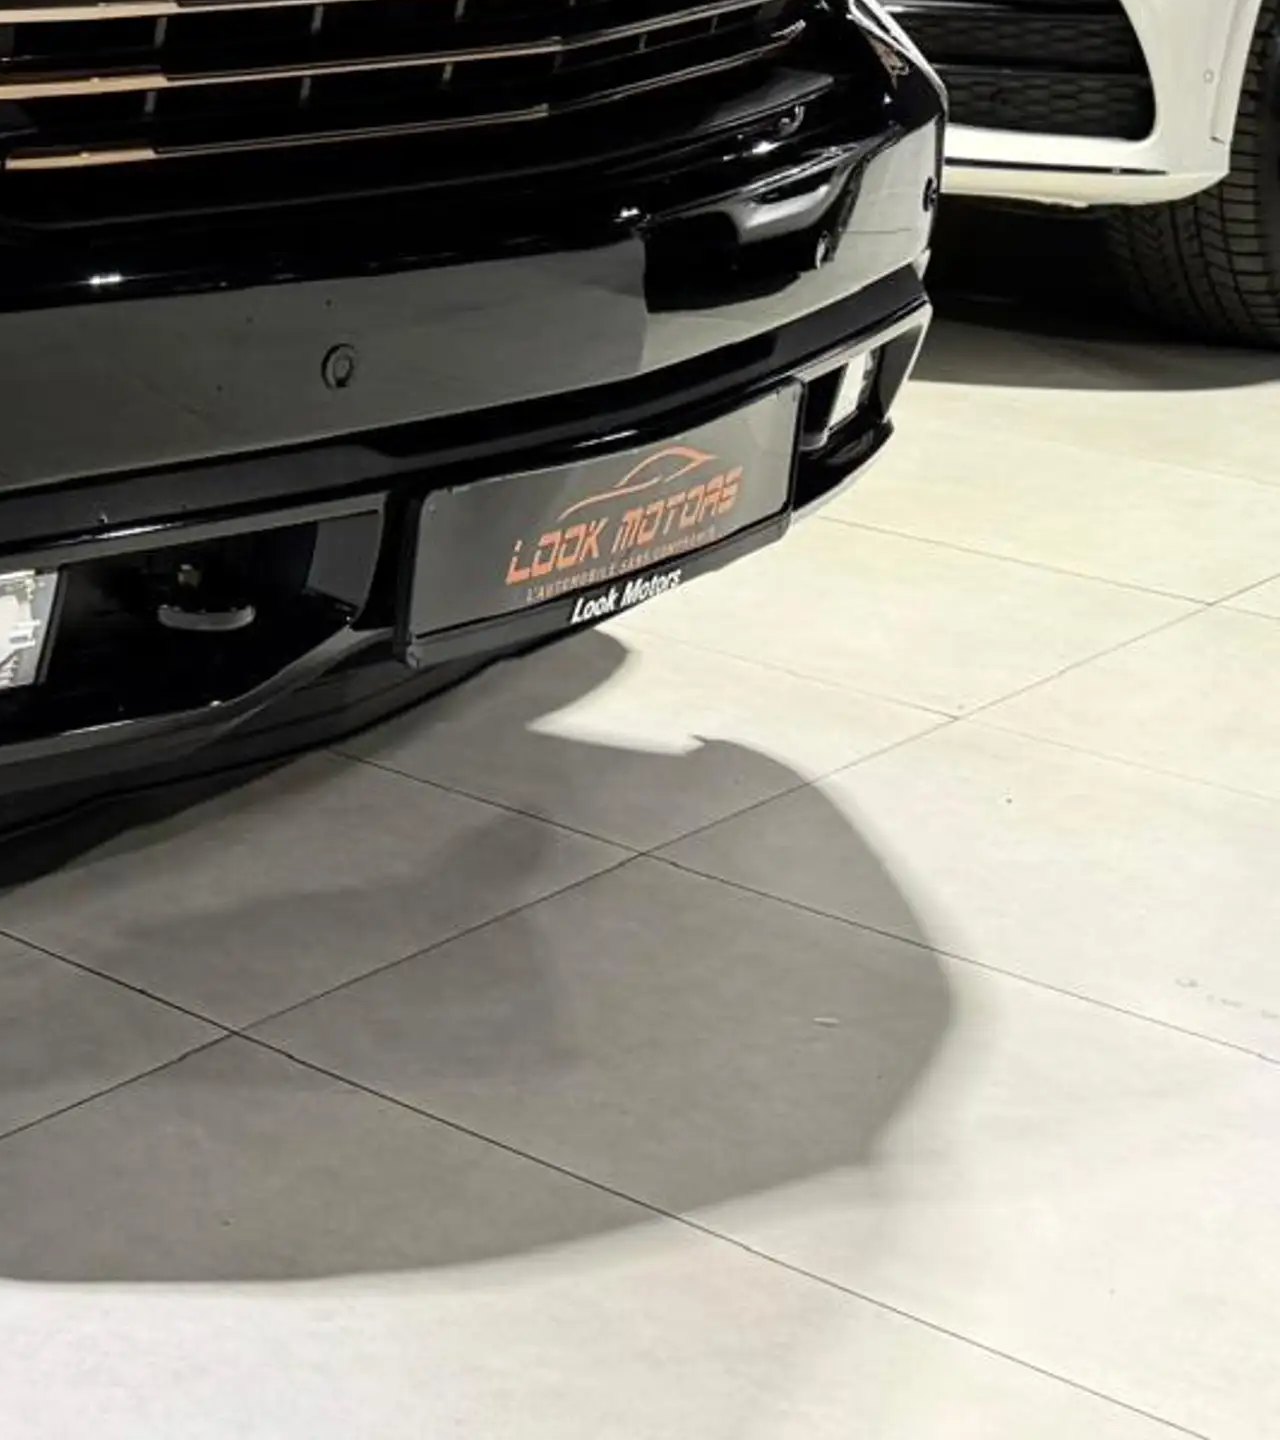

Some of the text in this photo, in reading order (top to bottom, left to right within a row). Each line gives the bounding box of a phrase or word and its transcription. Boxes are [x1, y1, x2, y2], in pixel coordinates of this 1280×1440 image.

[506, 466, 743, 586] LOOK MOTORS
[571, 568, 682, 624] Look Motors
